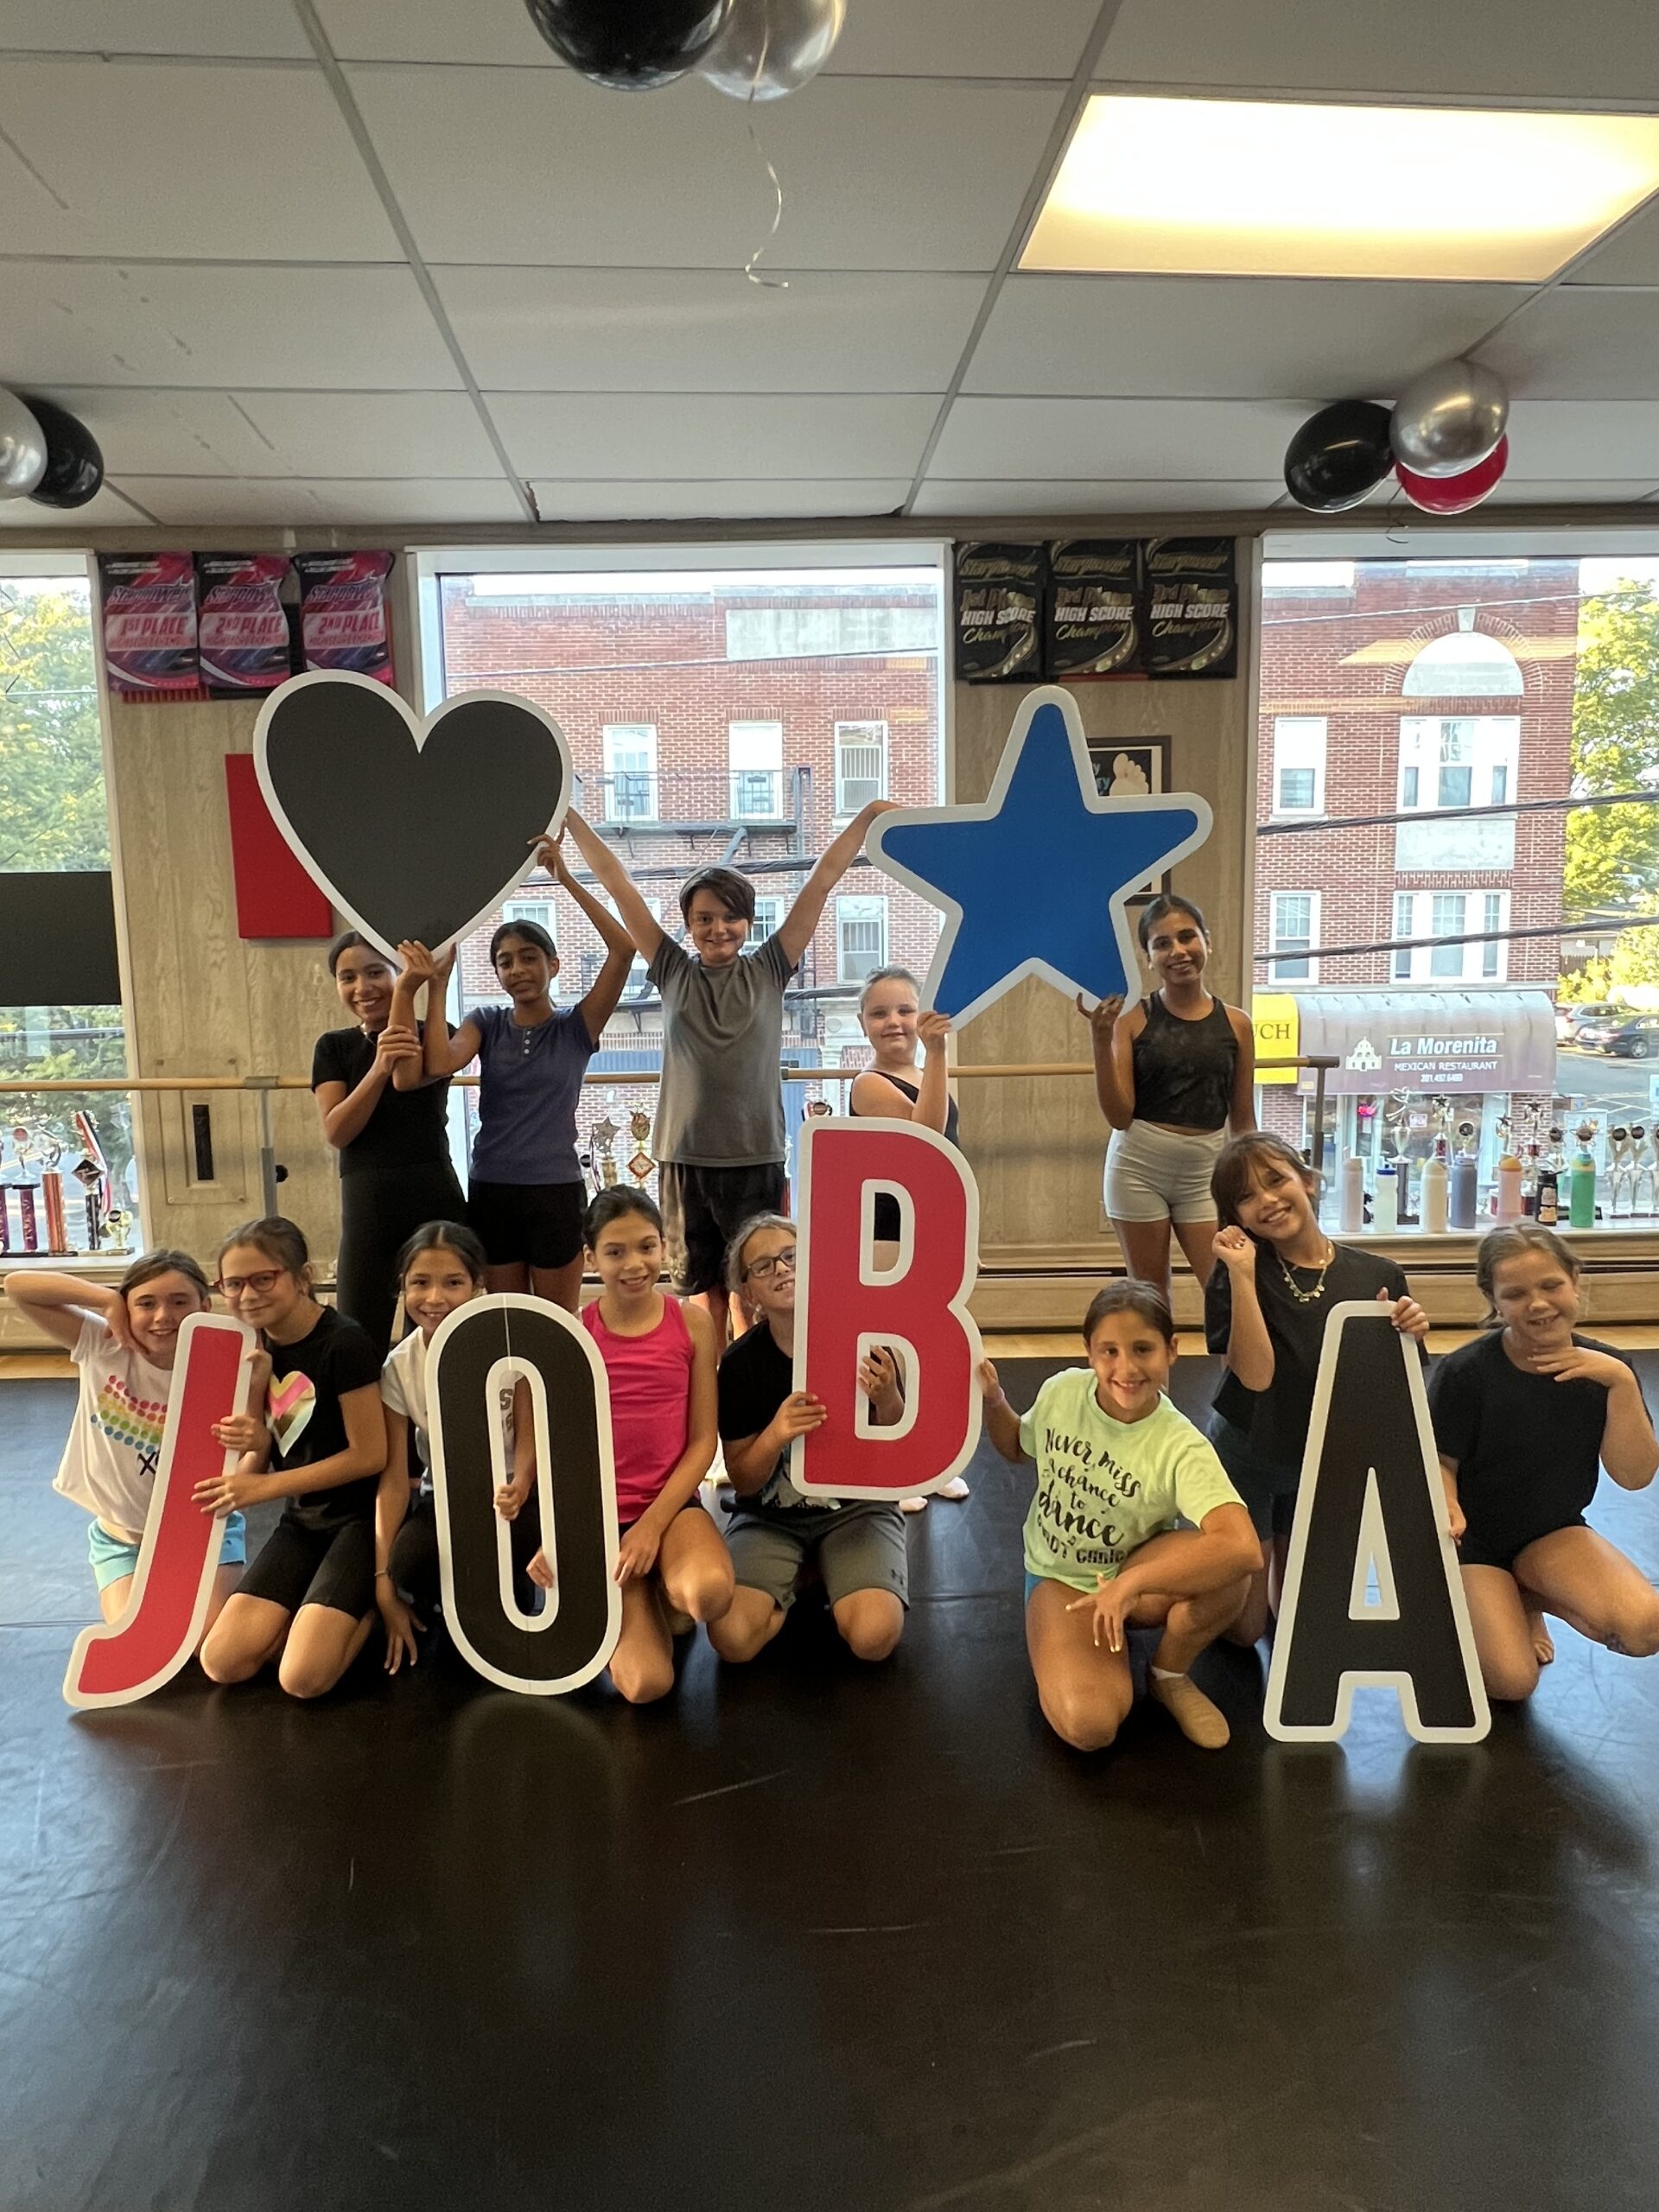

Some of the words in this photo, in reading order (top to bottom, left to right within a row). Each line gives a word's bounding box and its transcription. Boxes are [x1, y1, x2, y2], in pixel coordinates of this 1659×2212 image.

[961, 610, 995, 626] HIGH
[995, 607, 1036, 625] SCORE
[1054, 607, 1088, 622] HIGH
[1088, 606, 1134, 622] SCORE
[1150, 604, 1184, 620] HIGH
[1185, 603, 1230, 619] SCORE
[142, 616, 188, 635] PLACE
[241, 616, 283, 633] PLACE
[1390, 1038, 1411, 1055] La
[1417, 1037, 1497, 1054] Morenita
[1395, 1061, 1436, 1071] MEXICAN
[1438, 1061, 1498, 1071] RESTAURANT
[64, 1313, 257, 1709] J
[425, 1293, 622, 1694] O
[791, 1116, 983, 1501] B
[1263, 1300, 1492, 1743] A
[1046, 1428, 1093, 1465] Never
[1097, 1451, 1141, 1497] miss
[1058, 1465, 1120, 1507] chance
[1071, 1491, 1086, 1510] to
[1038, 1479, 1124, 1547] dance
